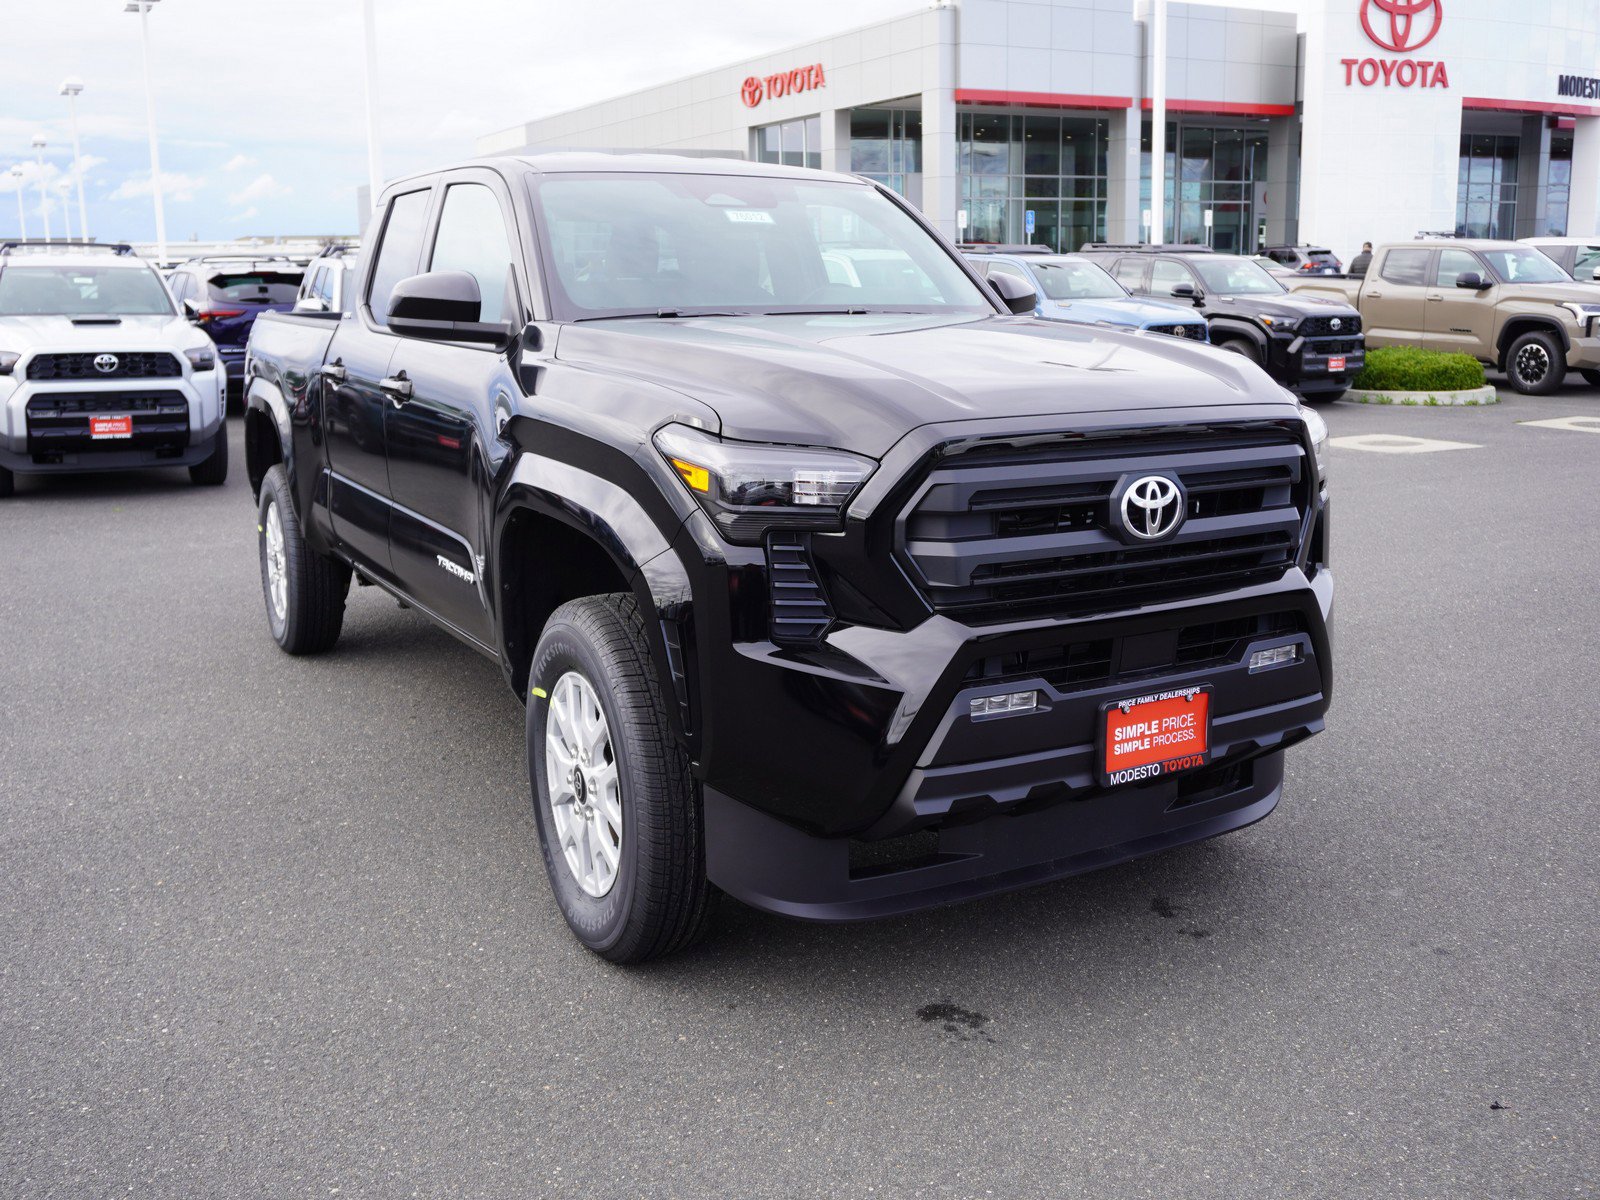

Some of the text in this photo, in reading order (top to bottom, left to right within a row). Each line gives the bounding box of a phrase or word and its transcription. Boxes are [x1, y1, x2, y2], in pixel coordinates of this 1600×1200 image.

[763, 63, 826, 100] TOYOTA
[1340, 57, 1449, 88] TOYOTA
[1558, 74, 1600, 99] MODEST
[437, 554, 474, 584] TACOMA
[1118, 687, 1201, 708] PRICE FAMILY DEALERSHIPS
[1114, 713, 1197, 741] SIMPLE PRICE.
[1114, 729, 1197, 755] SIMPLE PROCESS.
[1110, 755, 1204, 786] MODESTO TOYOTA
